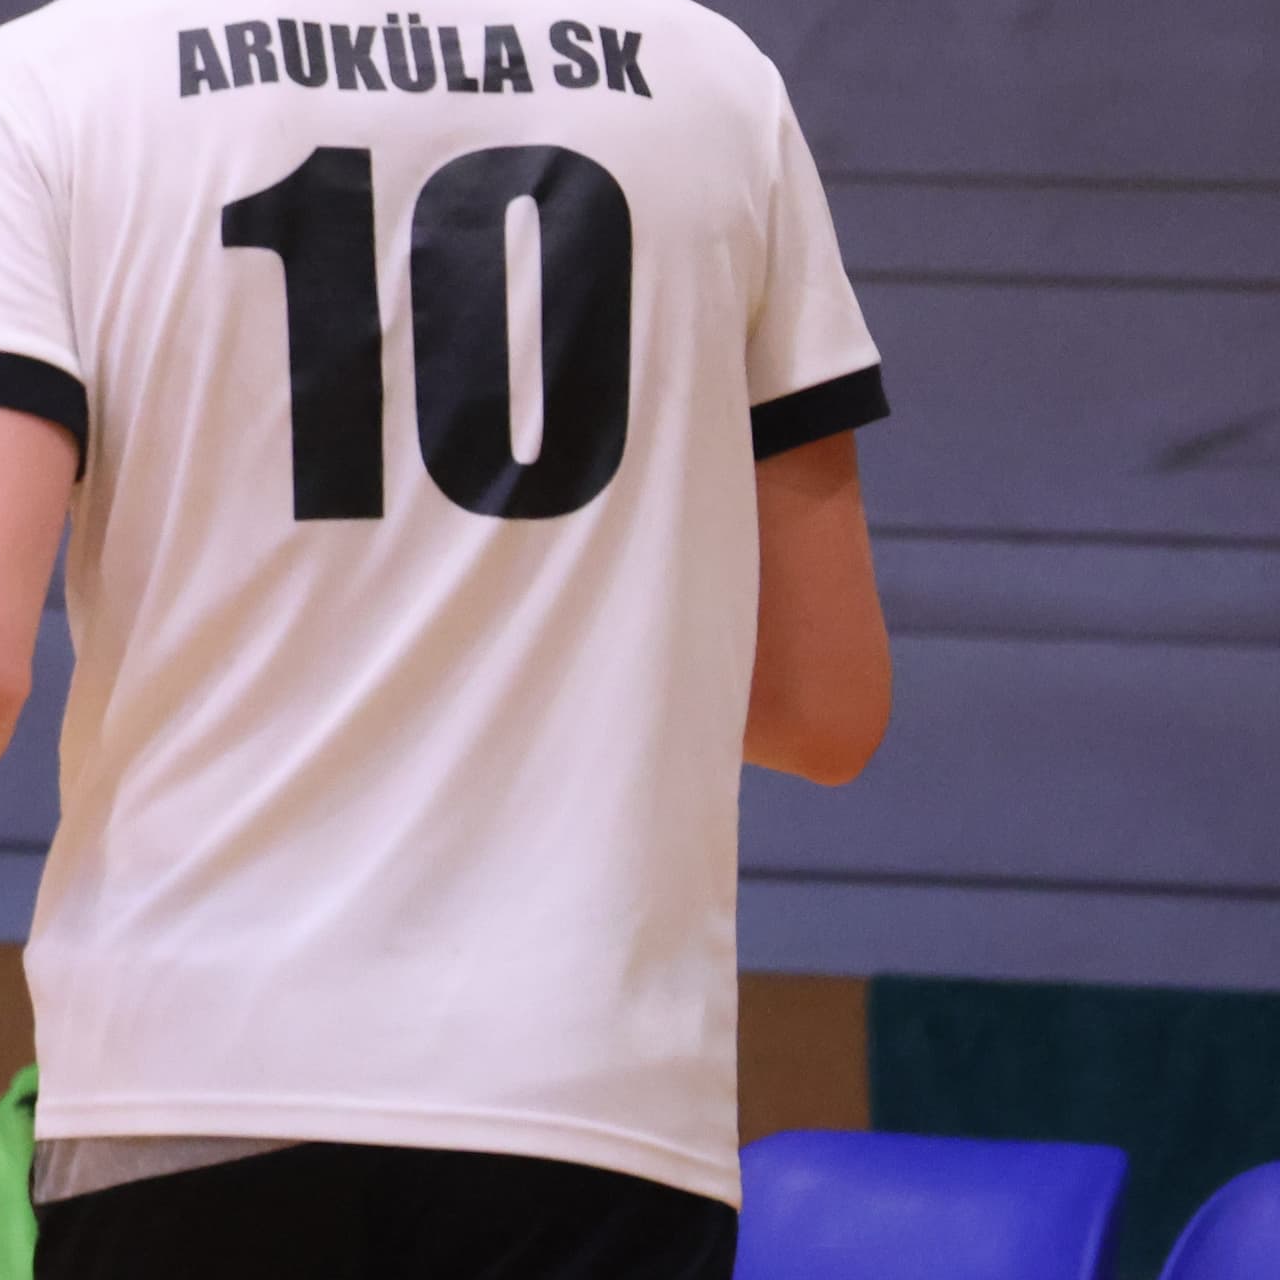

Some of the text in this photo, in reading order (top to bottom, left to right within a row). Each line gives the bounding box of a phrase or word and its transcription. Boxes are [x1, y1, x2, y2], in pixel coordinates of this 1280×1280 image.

[178, 13, 654, 99] ARUKÜLA SK
[221, 145, 632, 521] 10
